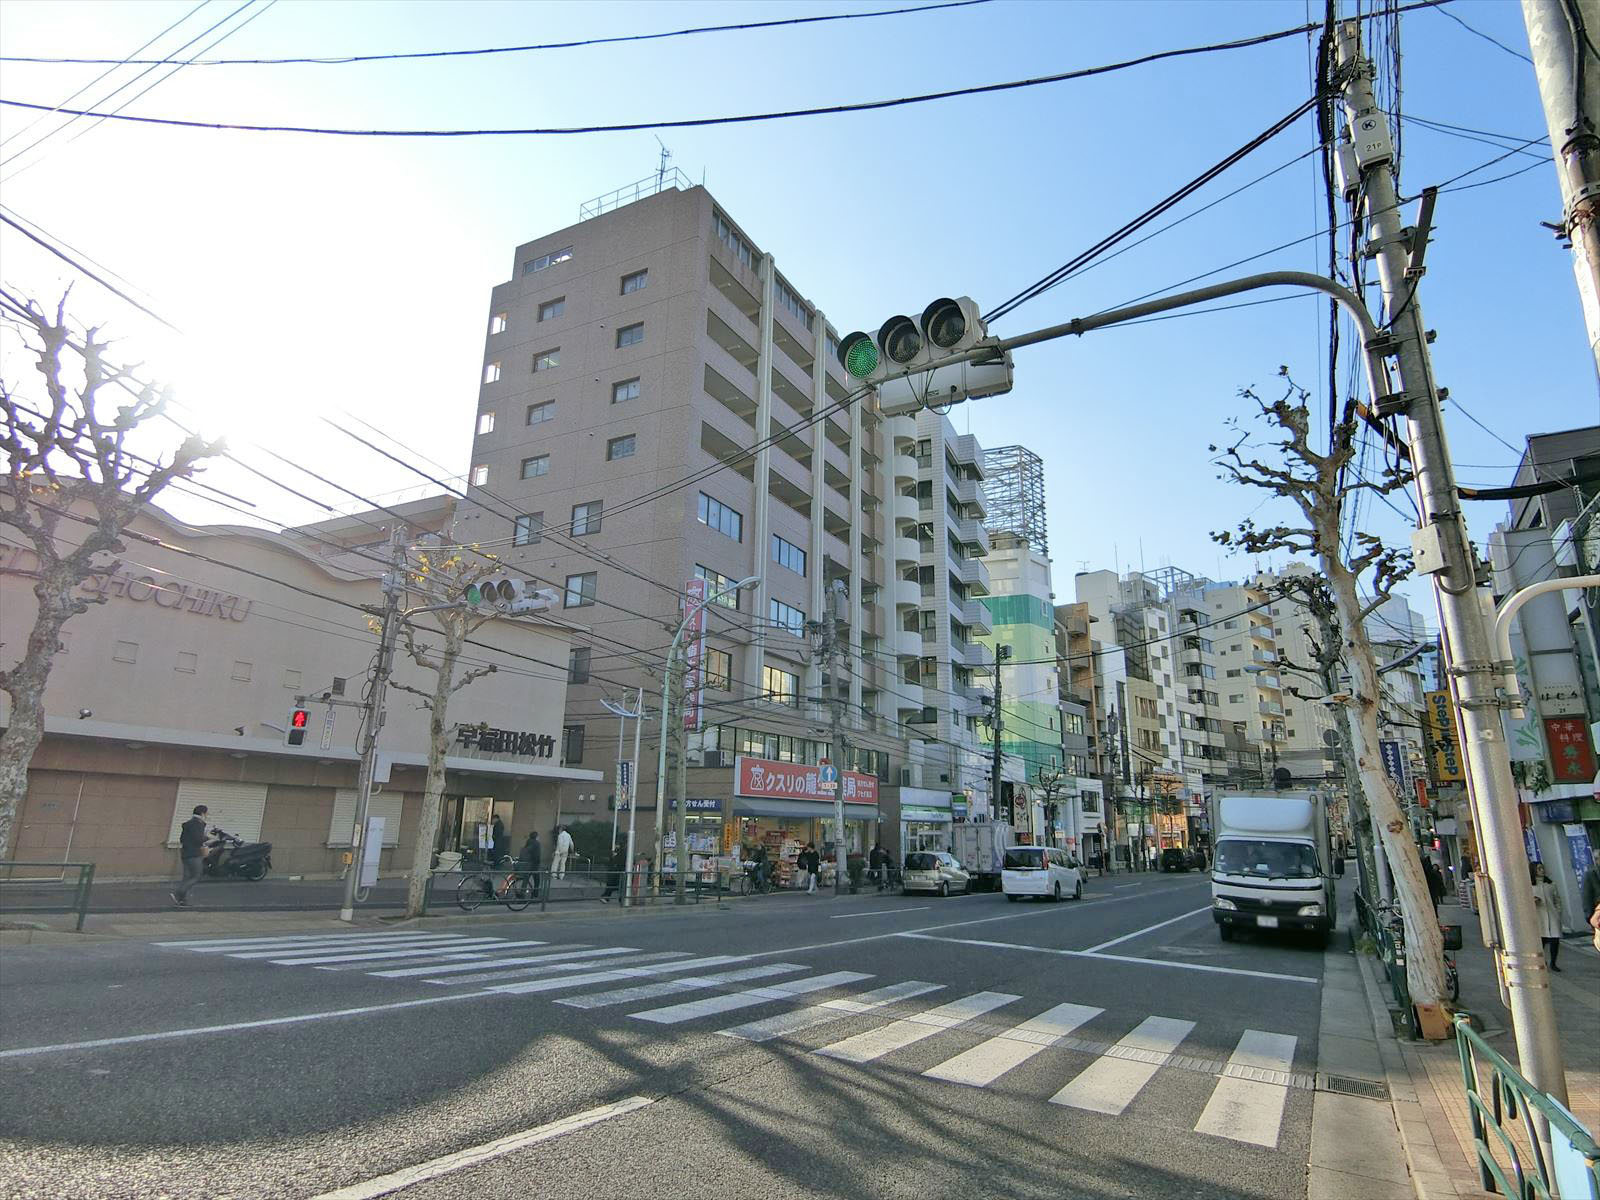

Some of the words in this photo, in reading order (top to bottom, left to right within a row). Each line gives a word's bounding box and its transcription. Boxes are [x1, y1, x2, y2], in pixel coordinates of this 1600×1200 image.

[81, 571, 254, 622] SHOCHIKU
[1432, 695, 1450, 727] Step
[766, 772, 856, 798] クスリの龍局
[684, 800, 716, 808] 方せん受付
